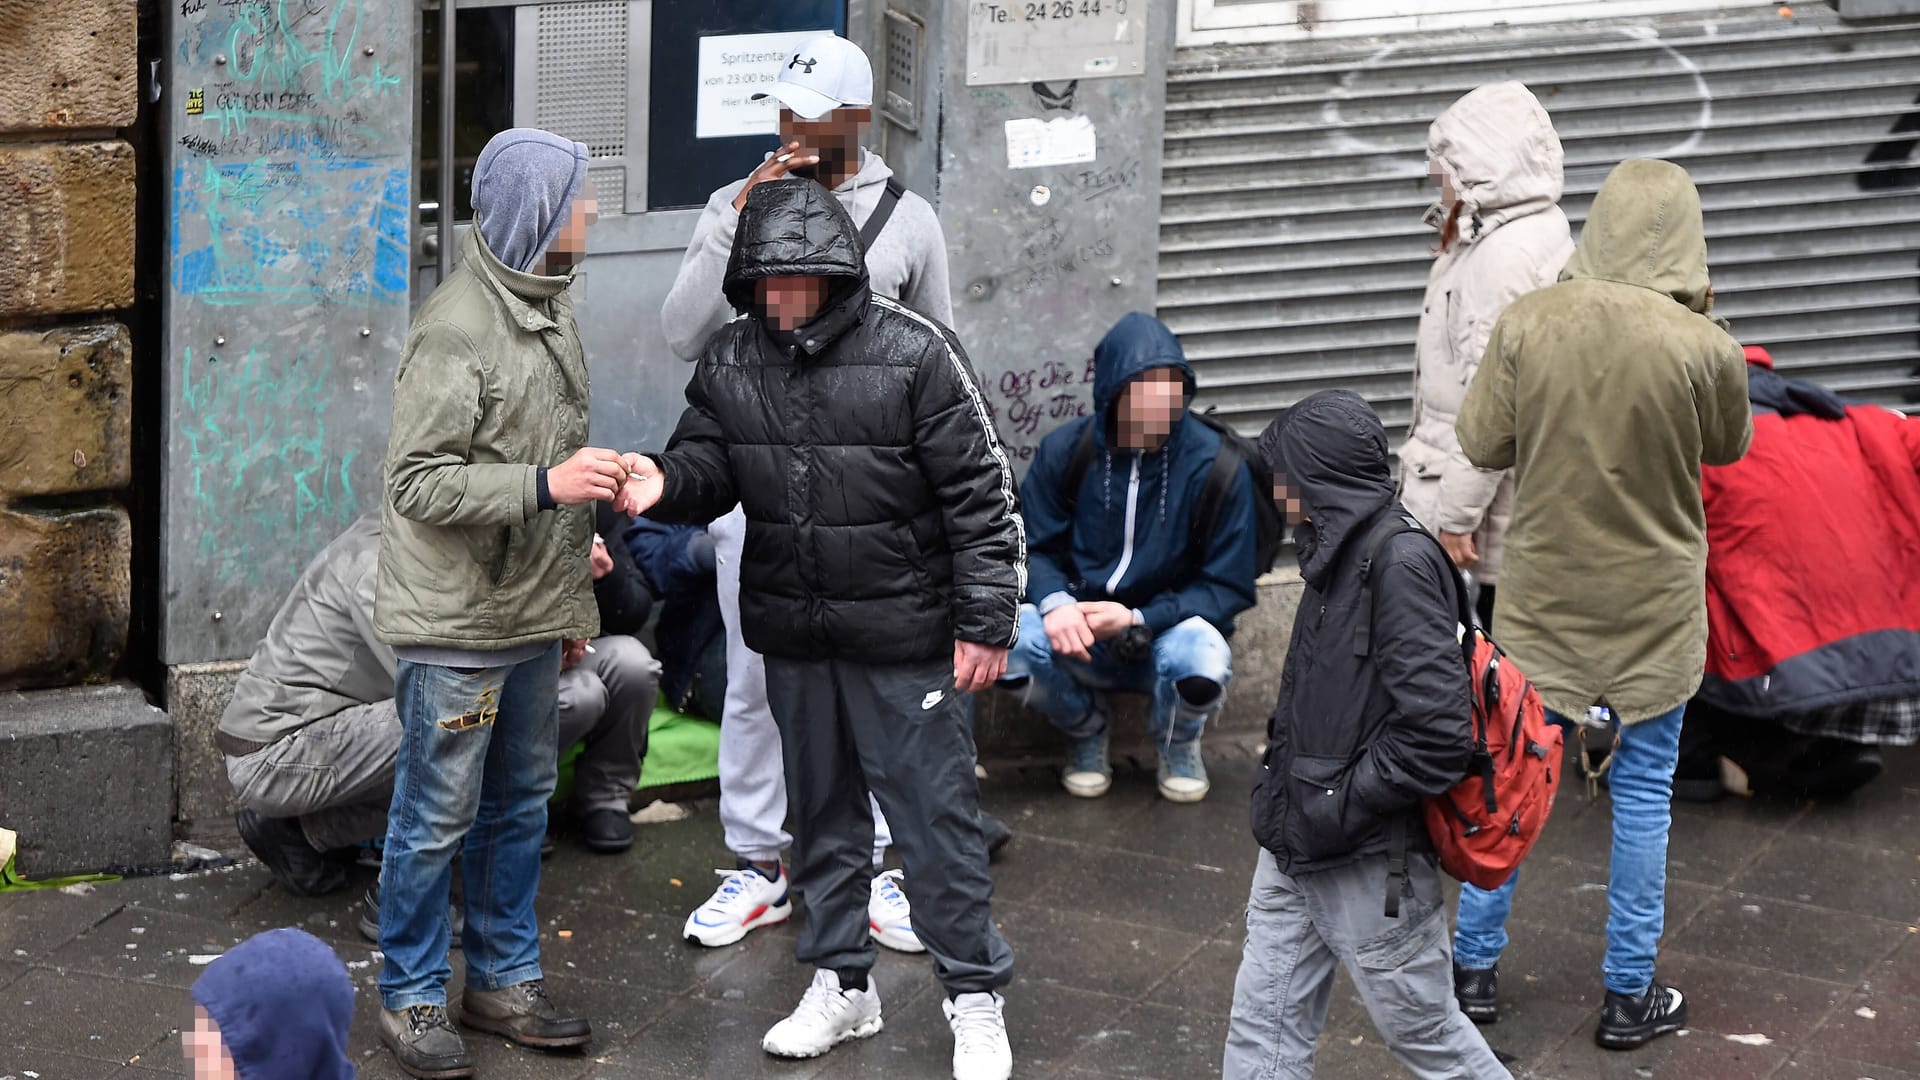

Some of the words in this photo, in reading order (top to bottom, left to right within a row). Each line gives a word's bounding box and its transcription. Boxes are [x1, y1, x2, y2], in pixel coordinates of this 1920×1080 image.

[1025, 3, 1047, 21] 24
[1052, 0, 1074, 19] 26
[760, 71, 775, 83] bis
[721, 97, 741, 107] Hier
[1000, 369, 1036, 398] Off
[1040, 361, 1074, 389] The
[1009, 400, 1044, 435] Off
[1050, 394, 1086, 419] The
